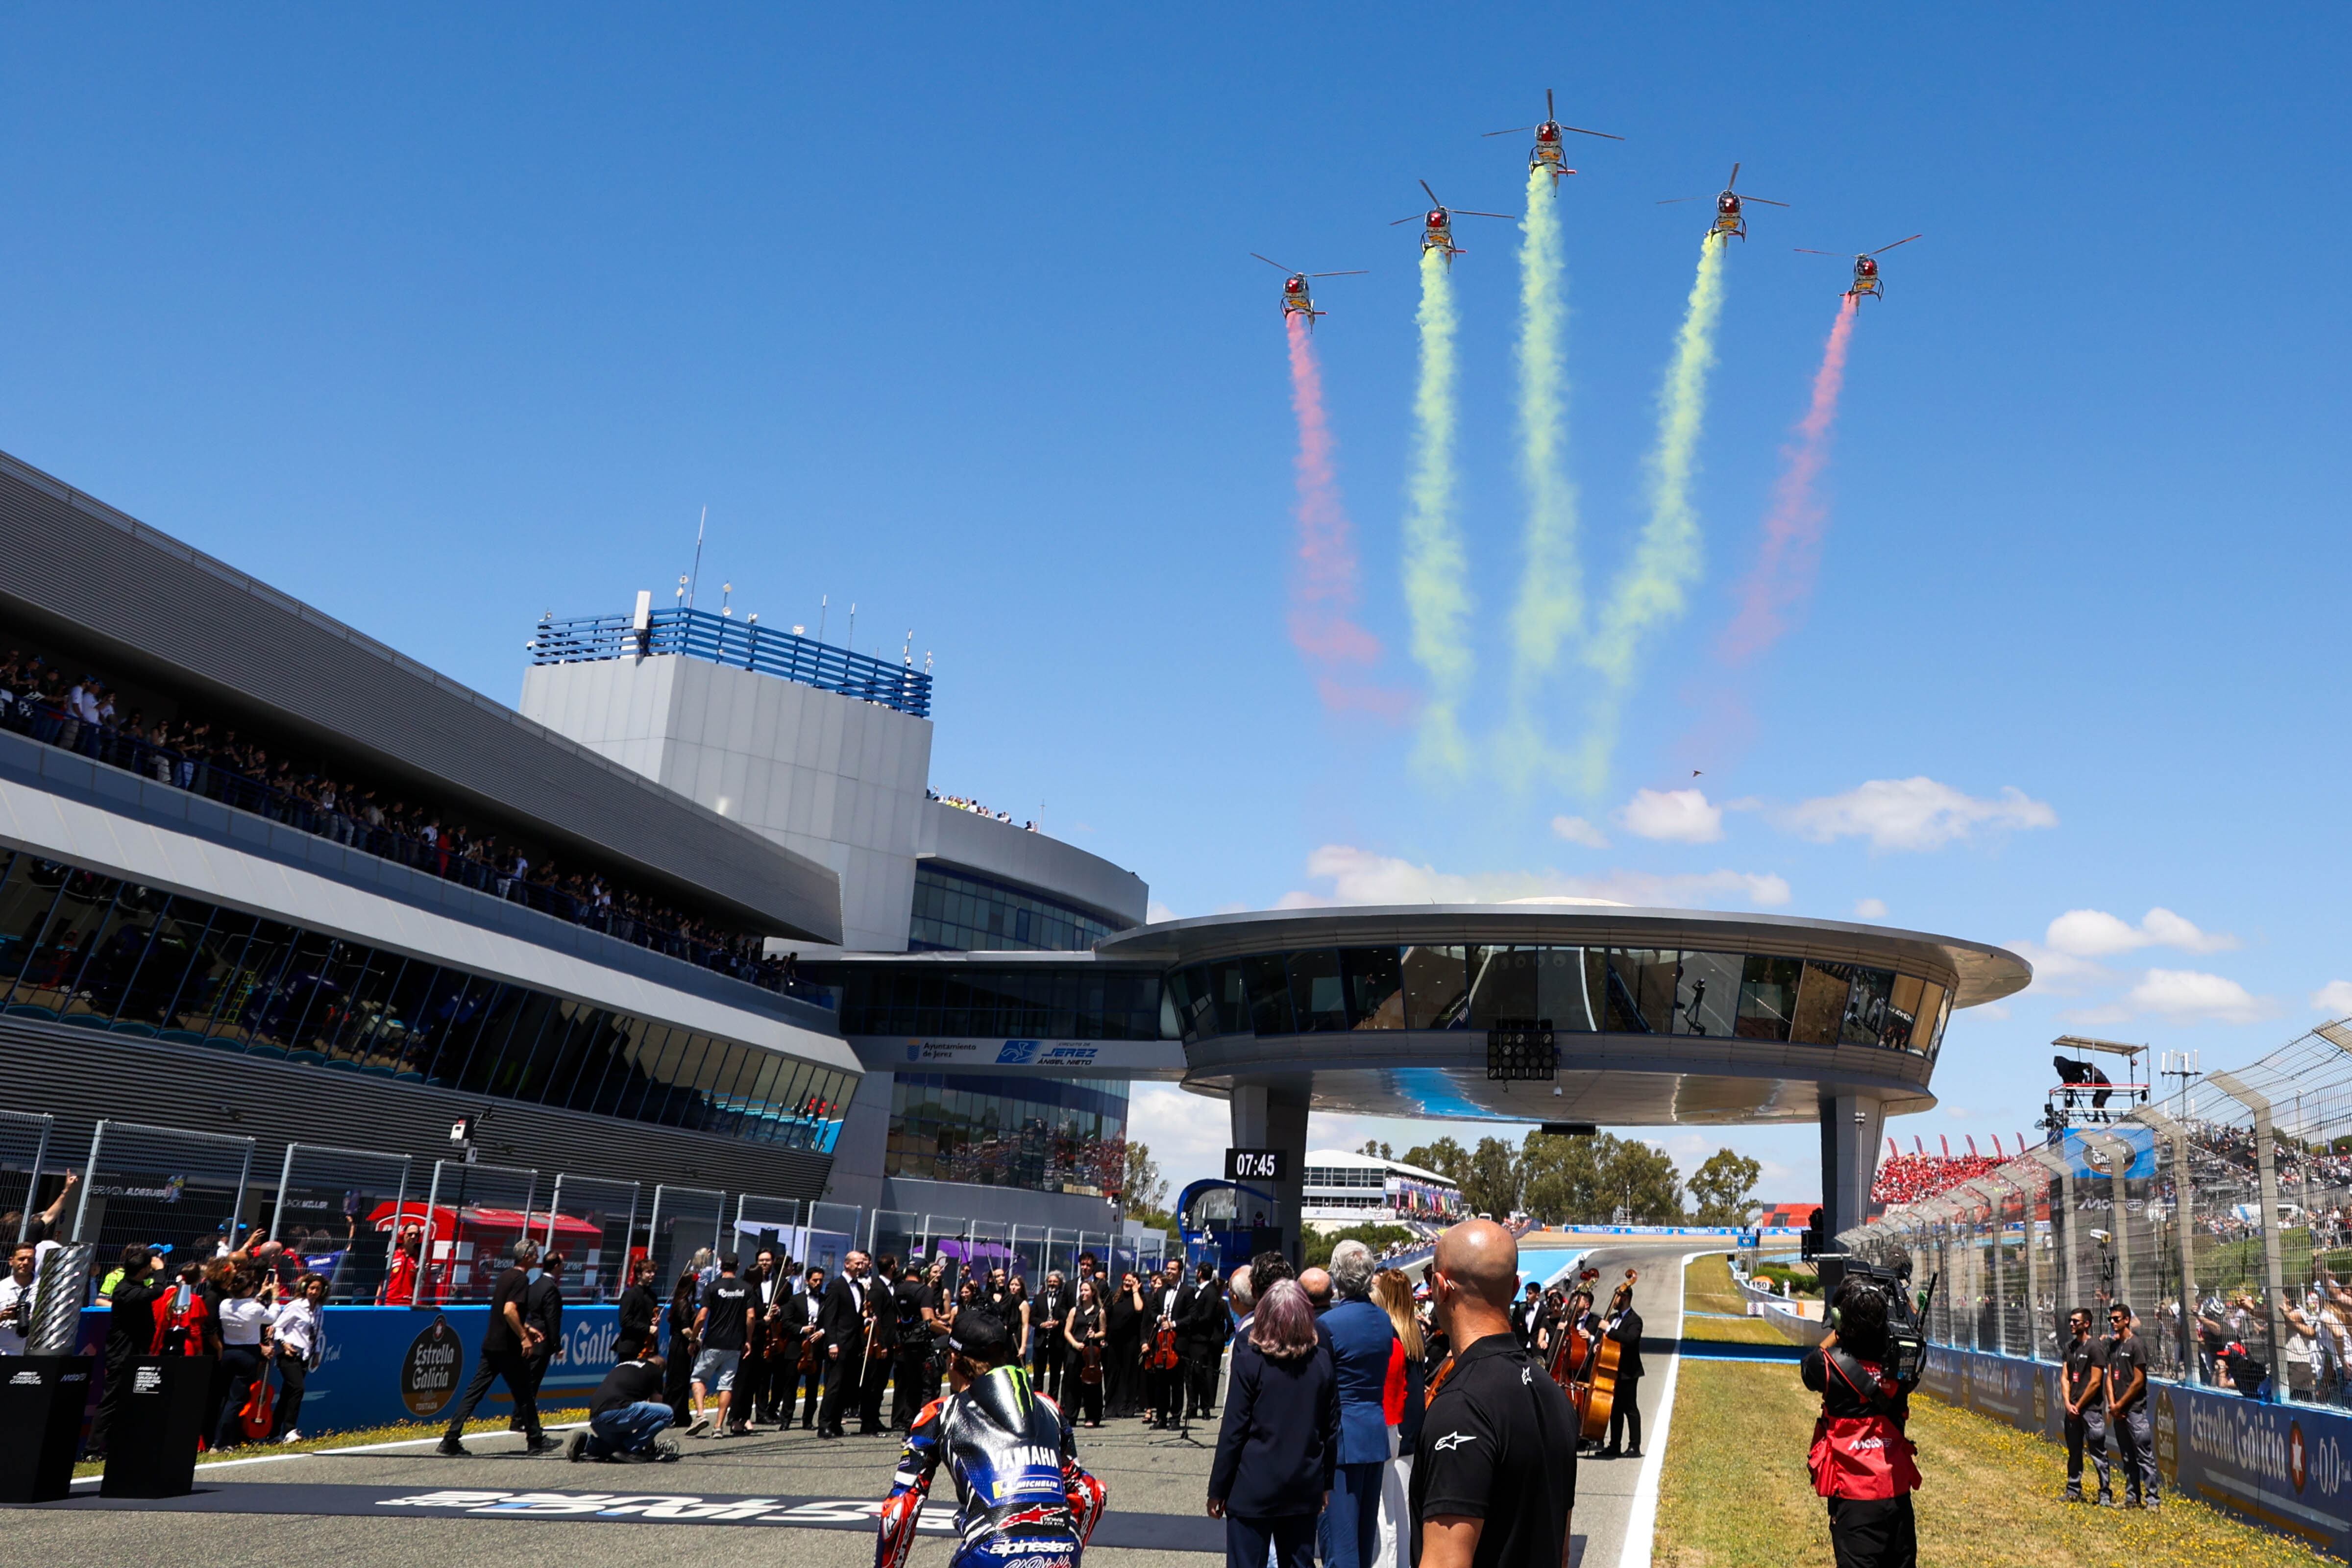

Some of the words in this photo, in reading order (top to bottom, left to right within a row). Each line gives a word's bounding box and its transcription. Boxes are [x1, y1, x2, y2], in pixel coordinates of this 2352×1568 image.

[923, 1042, 977, 1052] Ayuntamiento
[932, 1051, 952, 1059] Jerez
[1041, 1048, 1099, 1058] JEREZ
[1237, 1153, 1275, 1176] 07:45
[414, 1344, 454, 1366] Estrella
[412, 1366, 448, 1391] Galicia
[2190, 1396, 2235, 1464] Estrella
[2236, 1405, 2287, 1482] Galicia
[991, 1446, 1059, 1471] YAMAHA
[1017, 1480, 1058, 1489] MICHELIN
[989, 1540, 1074, 1558] alpinestars
